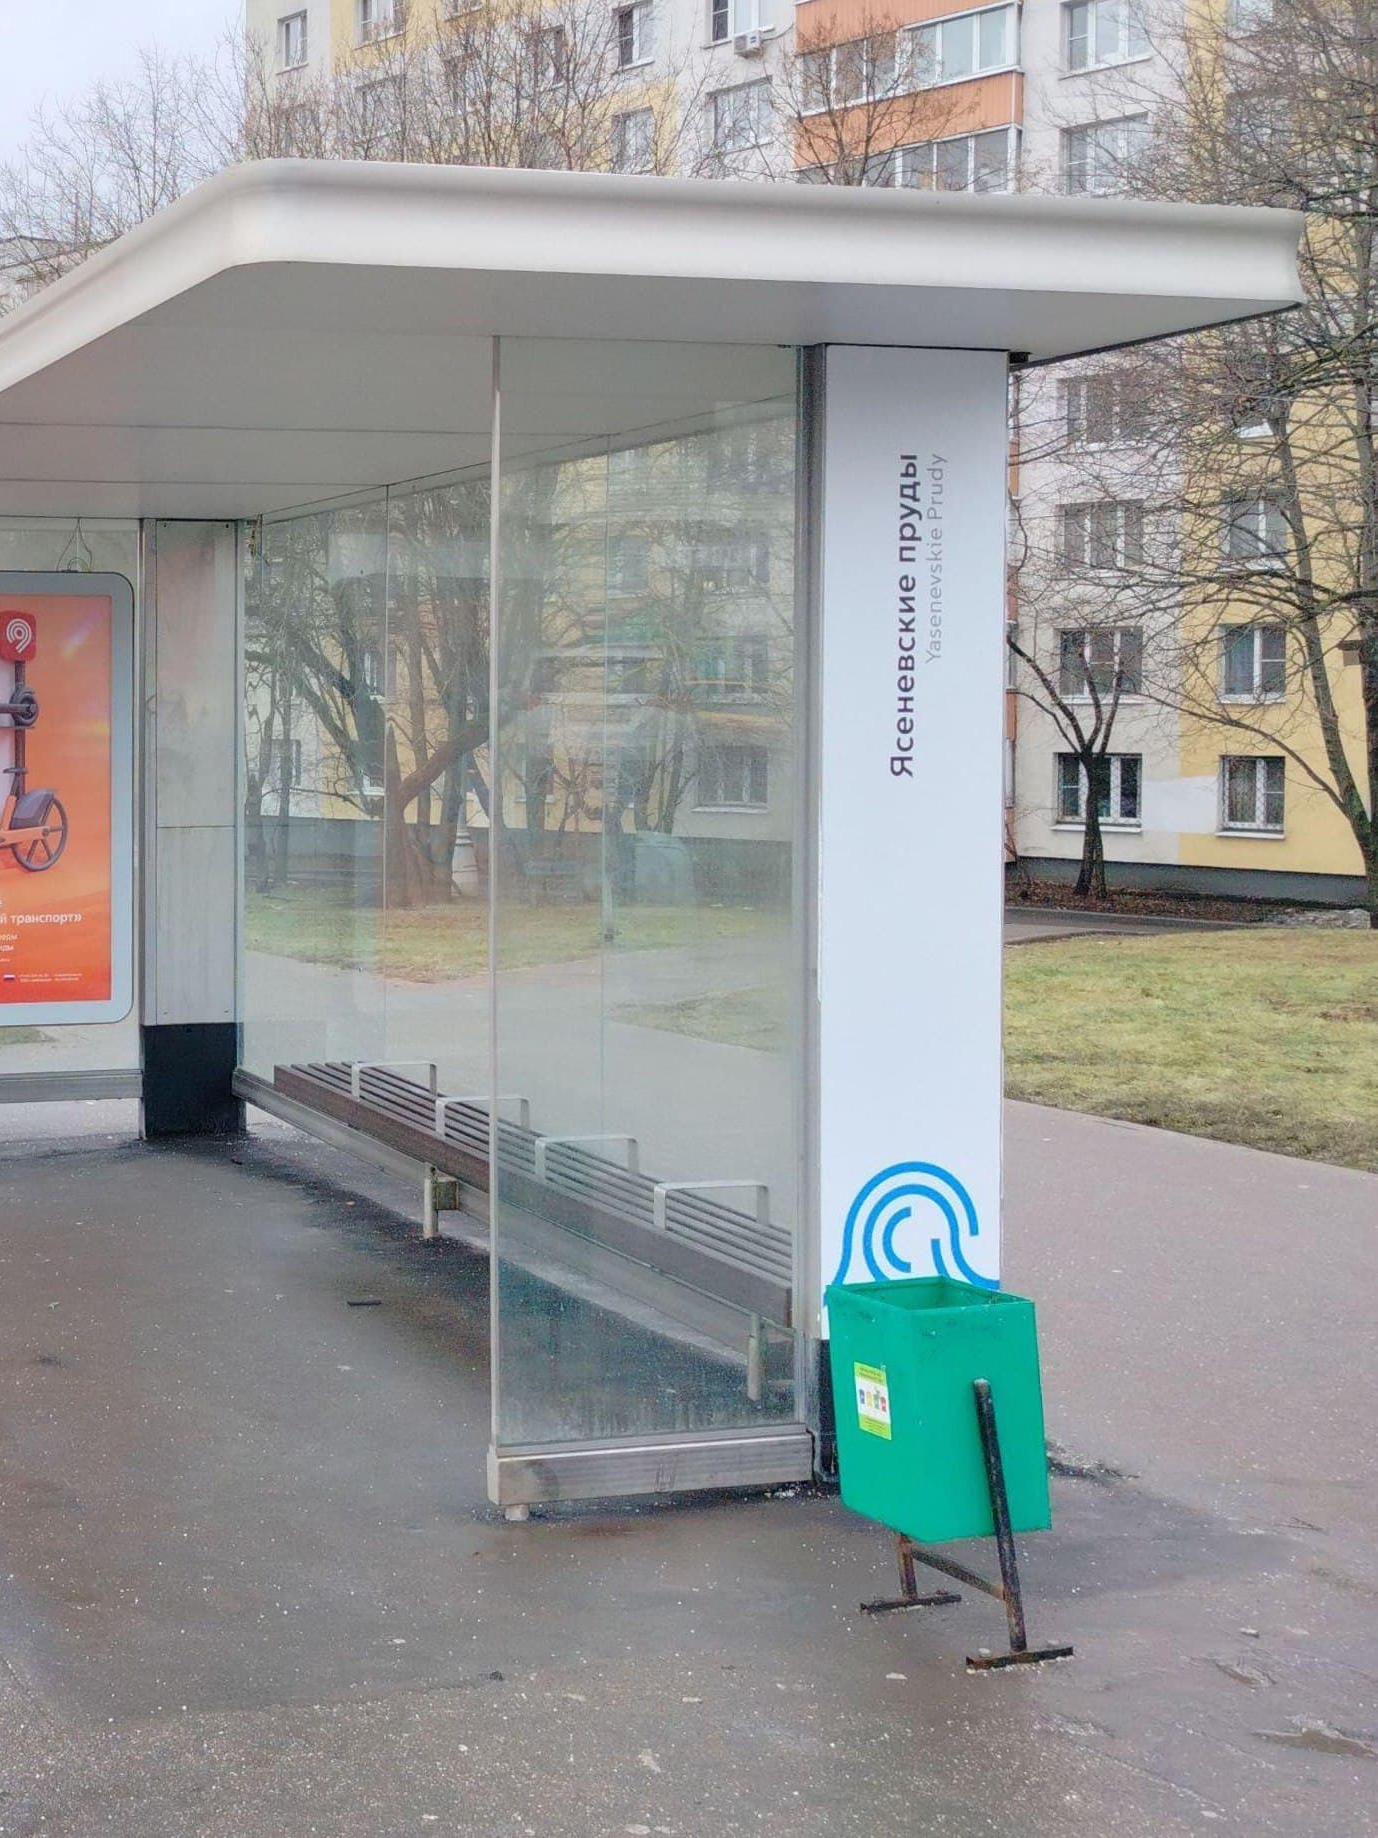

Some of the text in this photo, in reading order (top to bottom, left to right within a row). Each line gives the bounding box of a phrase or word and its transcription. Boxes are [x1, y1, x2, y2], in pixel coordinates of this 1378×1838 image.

[890, 454, 923, 778] Ясеневские пруды
[925, 453, 948, 665] Yasenevskie Prudy
[11, 914, 83, 925] транспорт»
